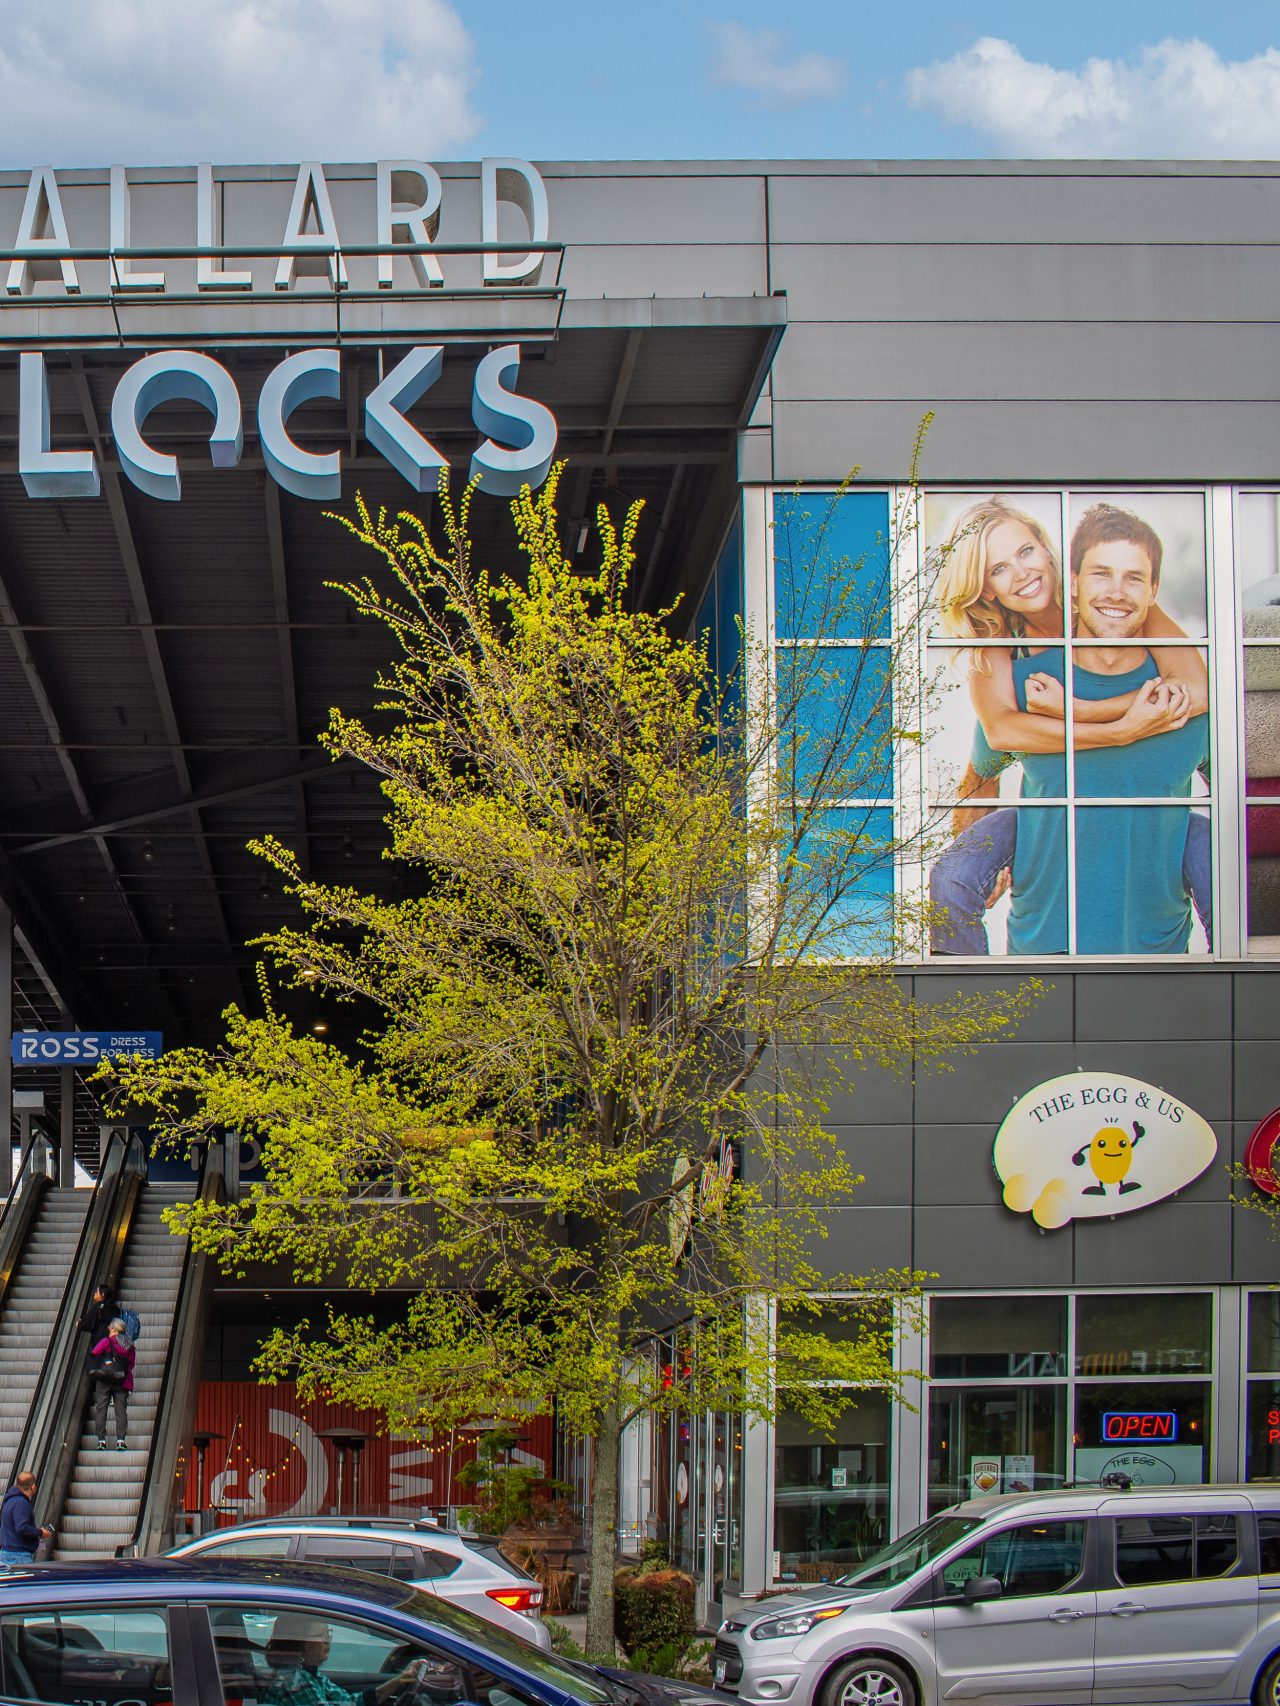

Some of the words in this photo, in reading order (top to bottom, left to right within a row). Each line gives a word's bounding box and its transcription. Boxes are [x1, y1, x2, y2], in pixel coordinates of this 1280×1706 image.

[22, 1037, 99, 1058] ROSS
[110, 1037, 146, 1047] DRESS
[100, 1048, 122, 1057] FOR
[126, 1048, 155, 1057] LESS
[1029, 1093, 1075, 1124] THE
[1080, 1087, 1128, 1106] EGG
[1135, 1091, 1151, 1110] &
[1157, 1097, 1185, 1124] US
[1107, 1415, 1171, 1438] OPEN
[1111, 1457, 1131, 1469] THE
[1132, 1456, 1156, 1467] EGG
